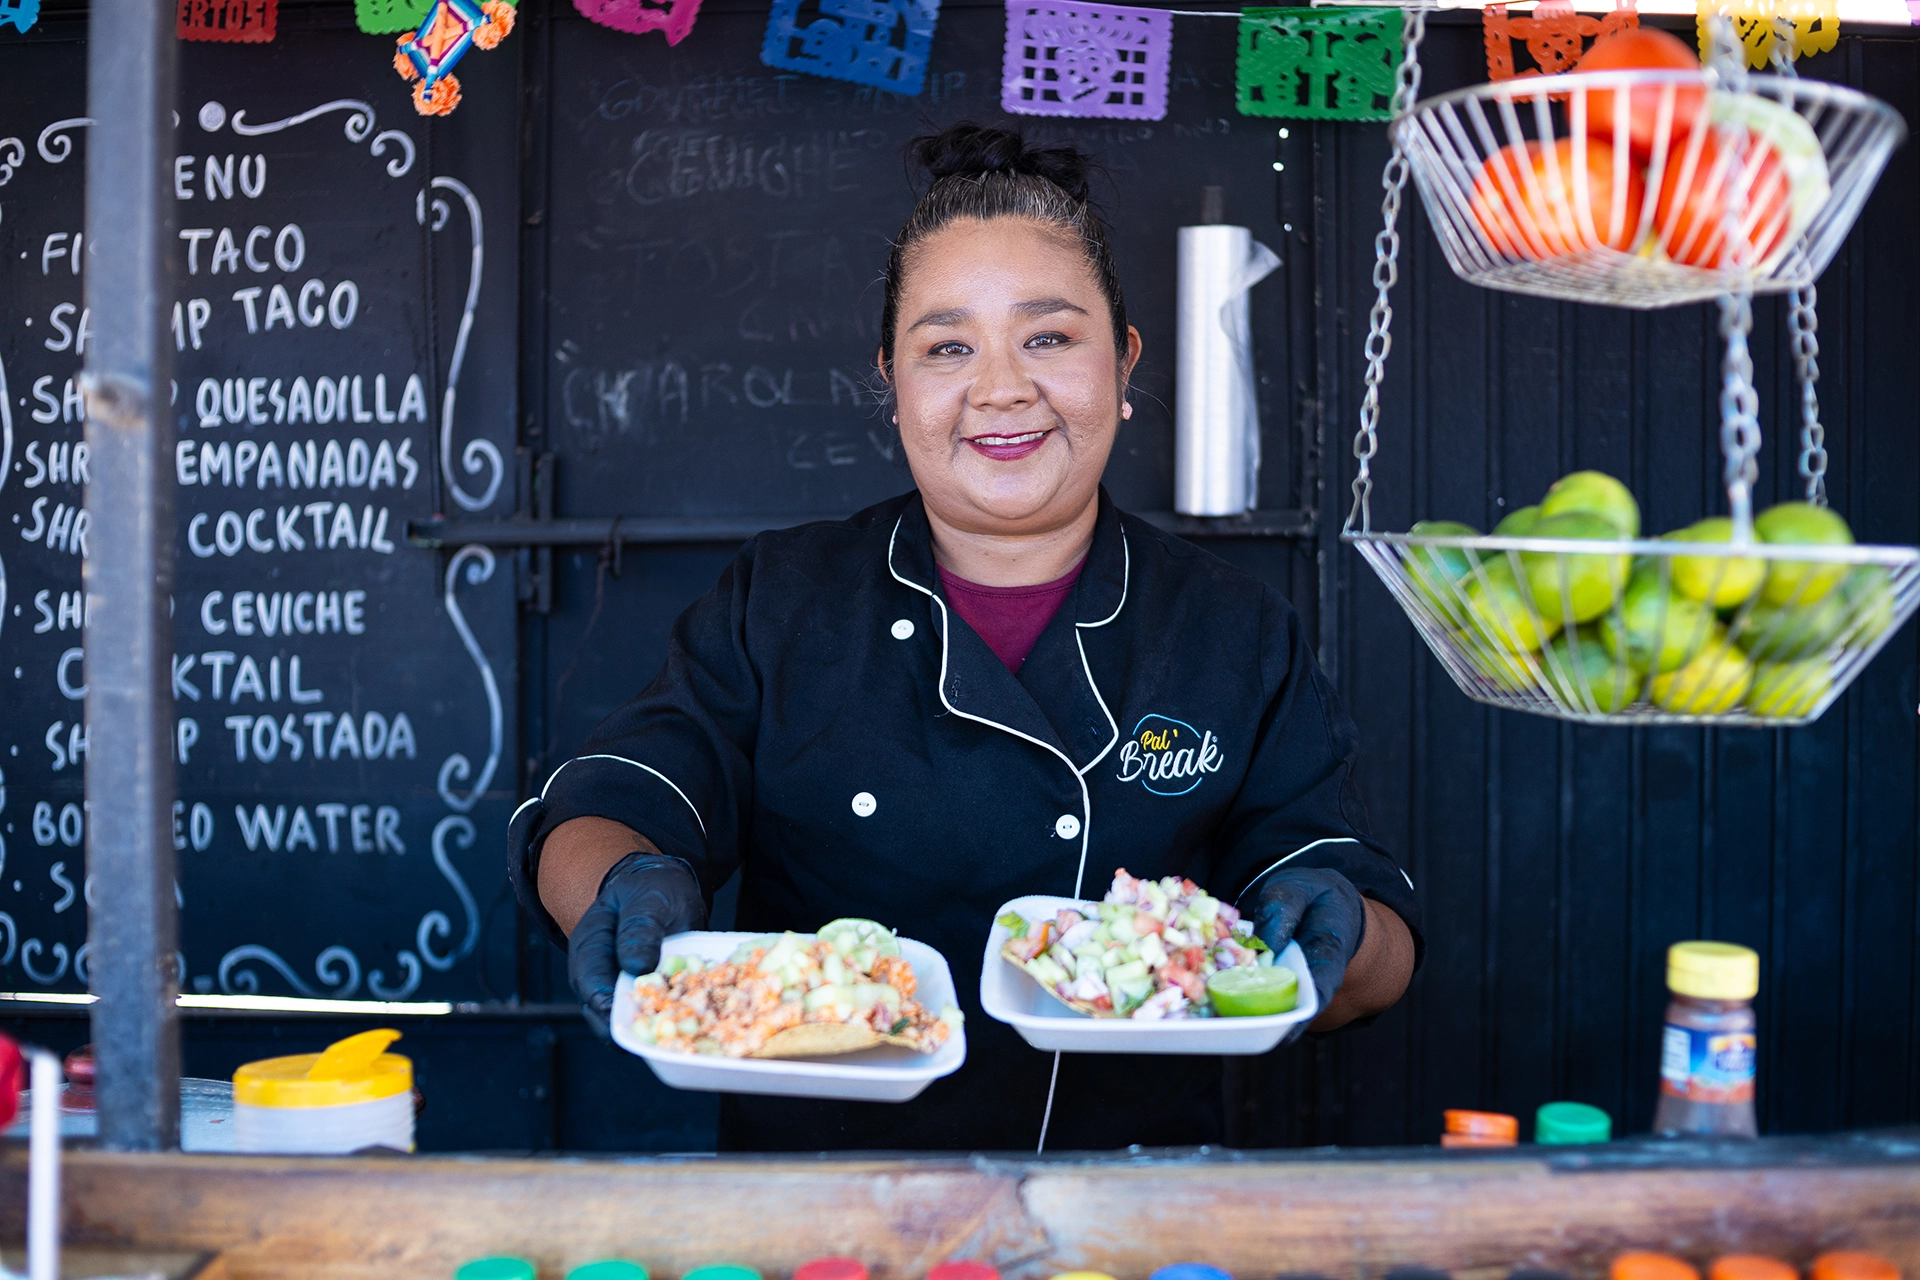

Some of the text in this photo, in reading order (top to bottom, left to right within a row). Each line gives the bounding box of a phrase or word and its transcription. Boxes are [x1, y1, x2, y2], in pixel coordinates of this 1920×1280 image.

[178, 0, 265, 31] ERTOS
[174, 153, 267, 201] ENU
[178, 222, 306, 276] TACO
[232, 278, 360, 335] TACO
[196, 373, 427, 428] QUESADILLA
[24, 437, 420, 490] SHR EMPANADAS
[21, 496, 396, 559] SHR COCKTAIL
[201, 588, 367, 637] CEVICHE
[57, 647, 324, 705] CKTAIL
[225, 711, 418, 763] TOSTADA
[1116, 730, 1224, 782] Break
[235, 803, 406, 855] WATER
